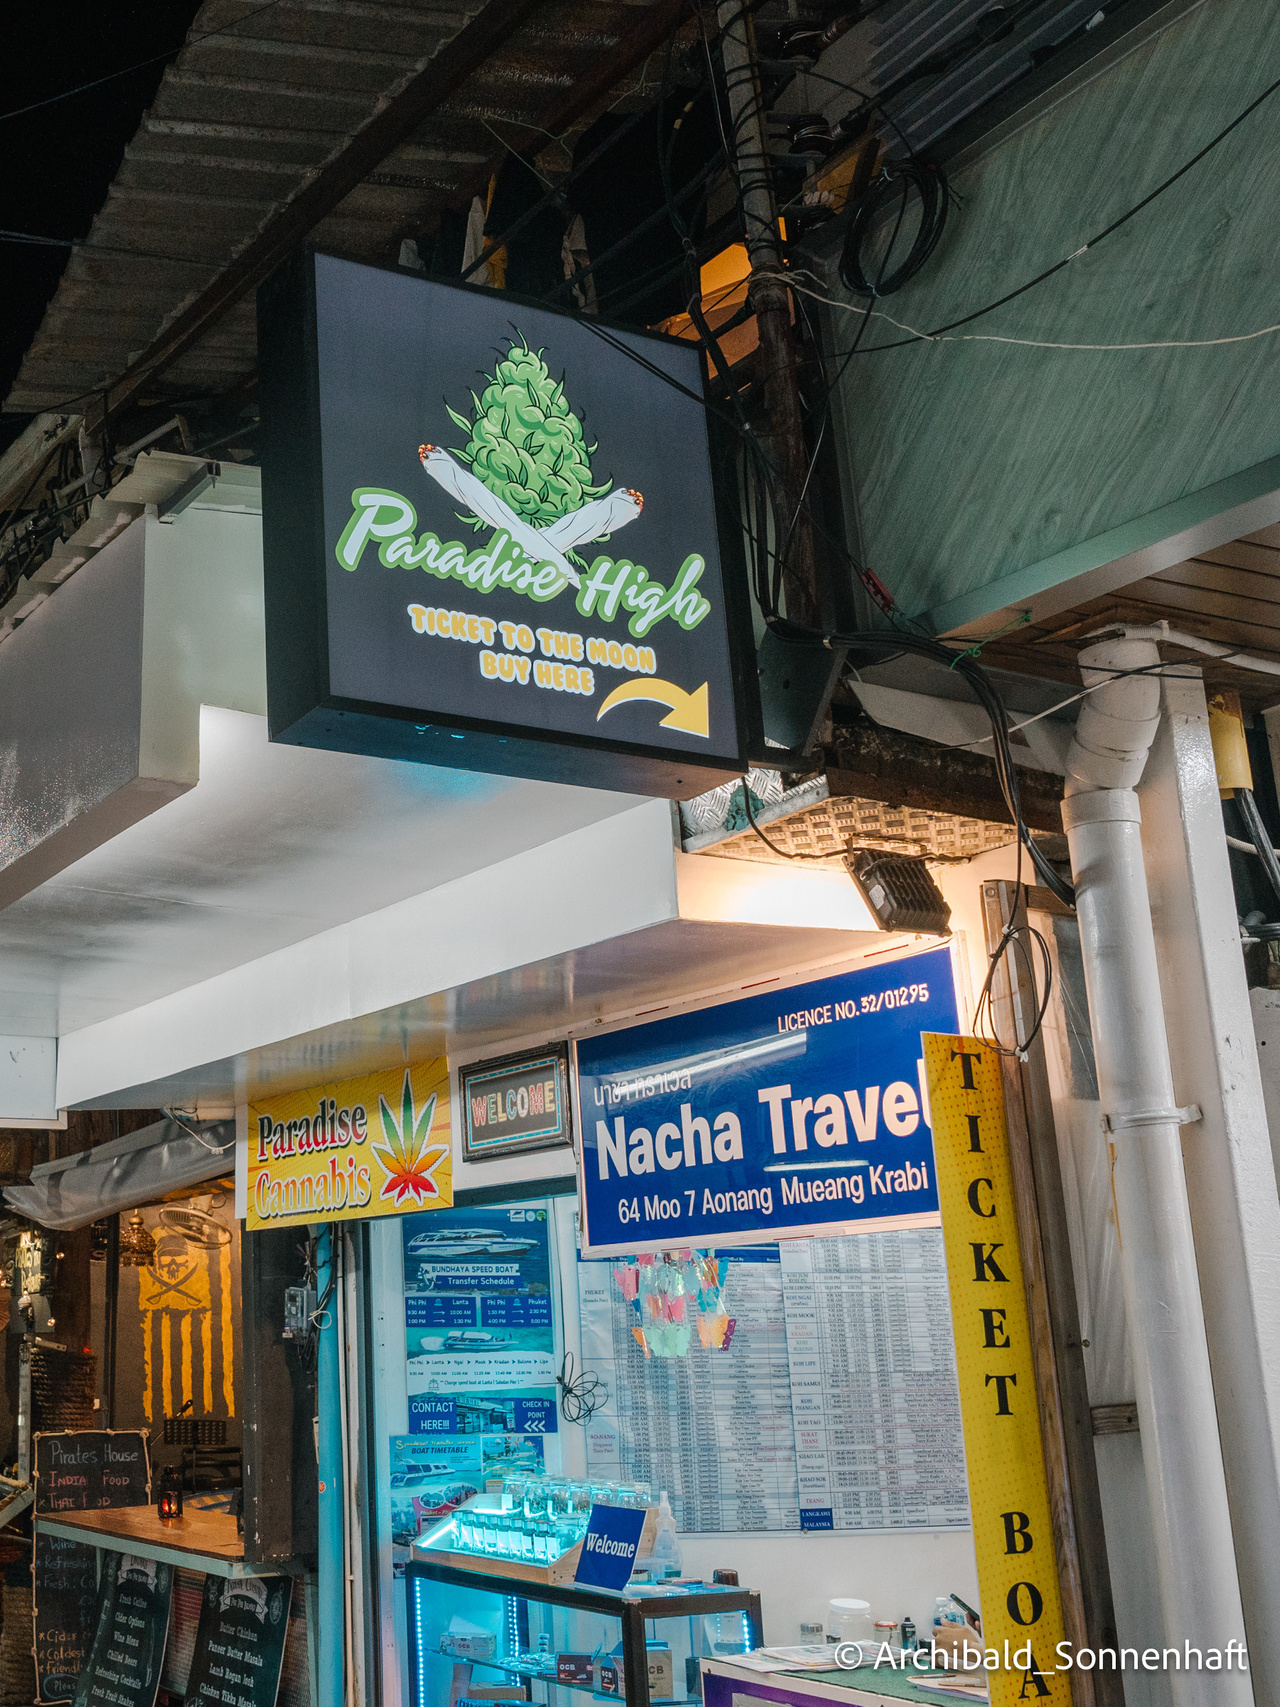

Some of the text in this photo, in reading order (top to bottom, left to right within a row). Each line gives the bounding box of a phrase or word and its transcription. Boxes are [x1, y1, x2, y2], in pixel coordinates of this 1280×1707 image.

[338, 490, 567, 599] Paradise
[578, 555, 709, 636] High
[408, 604, 657, 675] TICKET TO THE MOON
[479, 651, 595, 695] BUY HERE
[778, 1005, 832, 1033] LICENCE
[471, 1080, 556, 1127] WELCOME
[257, 1097, 368, 1161] Paradise
[595, 1103, 744, 1180] Nacha
[254, 1154, 371, 1218] Cannabis
[618, 1162, 929, 1223] 64 Moo 7 Aonang Mueang Krabi
[950, 1049, 1017, 1416] TICKET
[431, 1265, 514, 1273] BUNDHAYA SPEED BOAT
[448, 1277, 515, 1285] Transfer Schedule
[412, 1402, 454, 1413] CONTACT
[527, 1411, 546, 1419] POINT
[48, 1441, 139, 1465] Pirates House
[411, 1446, 469, 1455] BOAT TIMETABLE
[49, 1470, 130, 1488] INDIA FOOD
[49, 1537, 76, 1550] Wine
[586, 1532, 635, 1558] Welcome
[115, 1612, 145, 1628] Cider Options
[114, 1631, 139, 1647] Wine Menu
[236, 1626, 258, 1642] Chicken
[46, 1647, 86, 1661] Coldest
[107, 1649, 138, 1667] Chilled Beers
[208, 1640, 263, 1667] Paneer Butter Masala
[95, 1666, 142, 1689] Refreshing Cocktails
[209, 1662, 255, 1688] Lamb Rogan Josh
[601, 1669, 613, 1678] OCB
[199, 1682, 220, 1699] Chicken
[221, 1689, 236, 1705] Tikka
